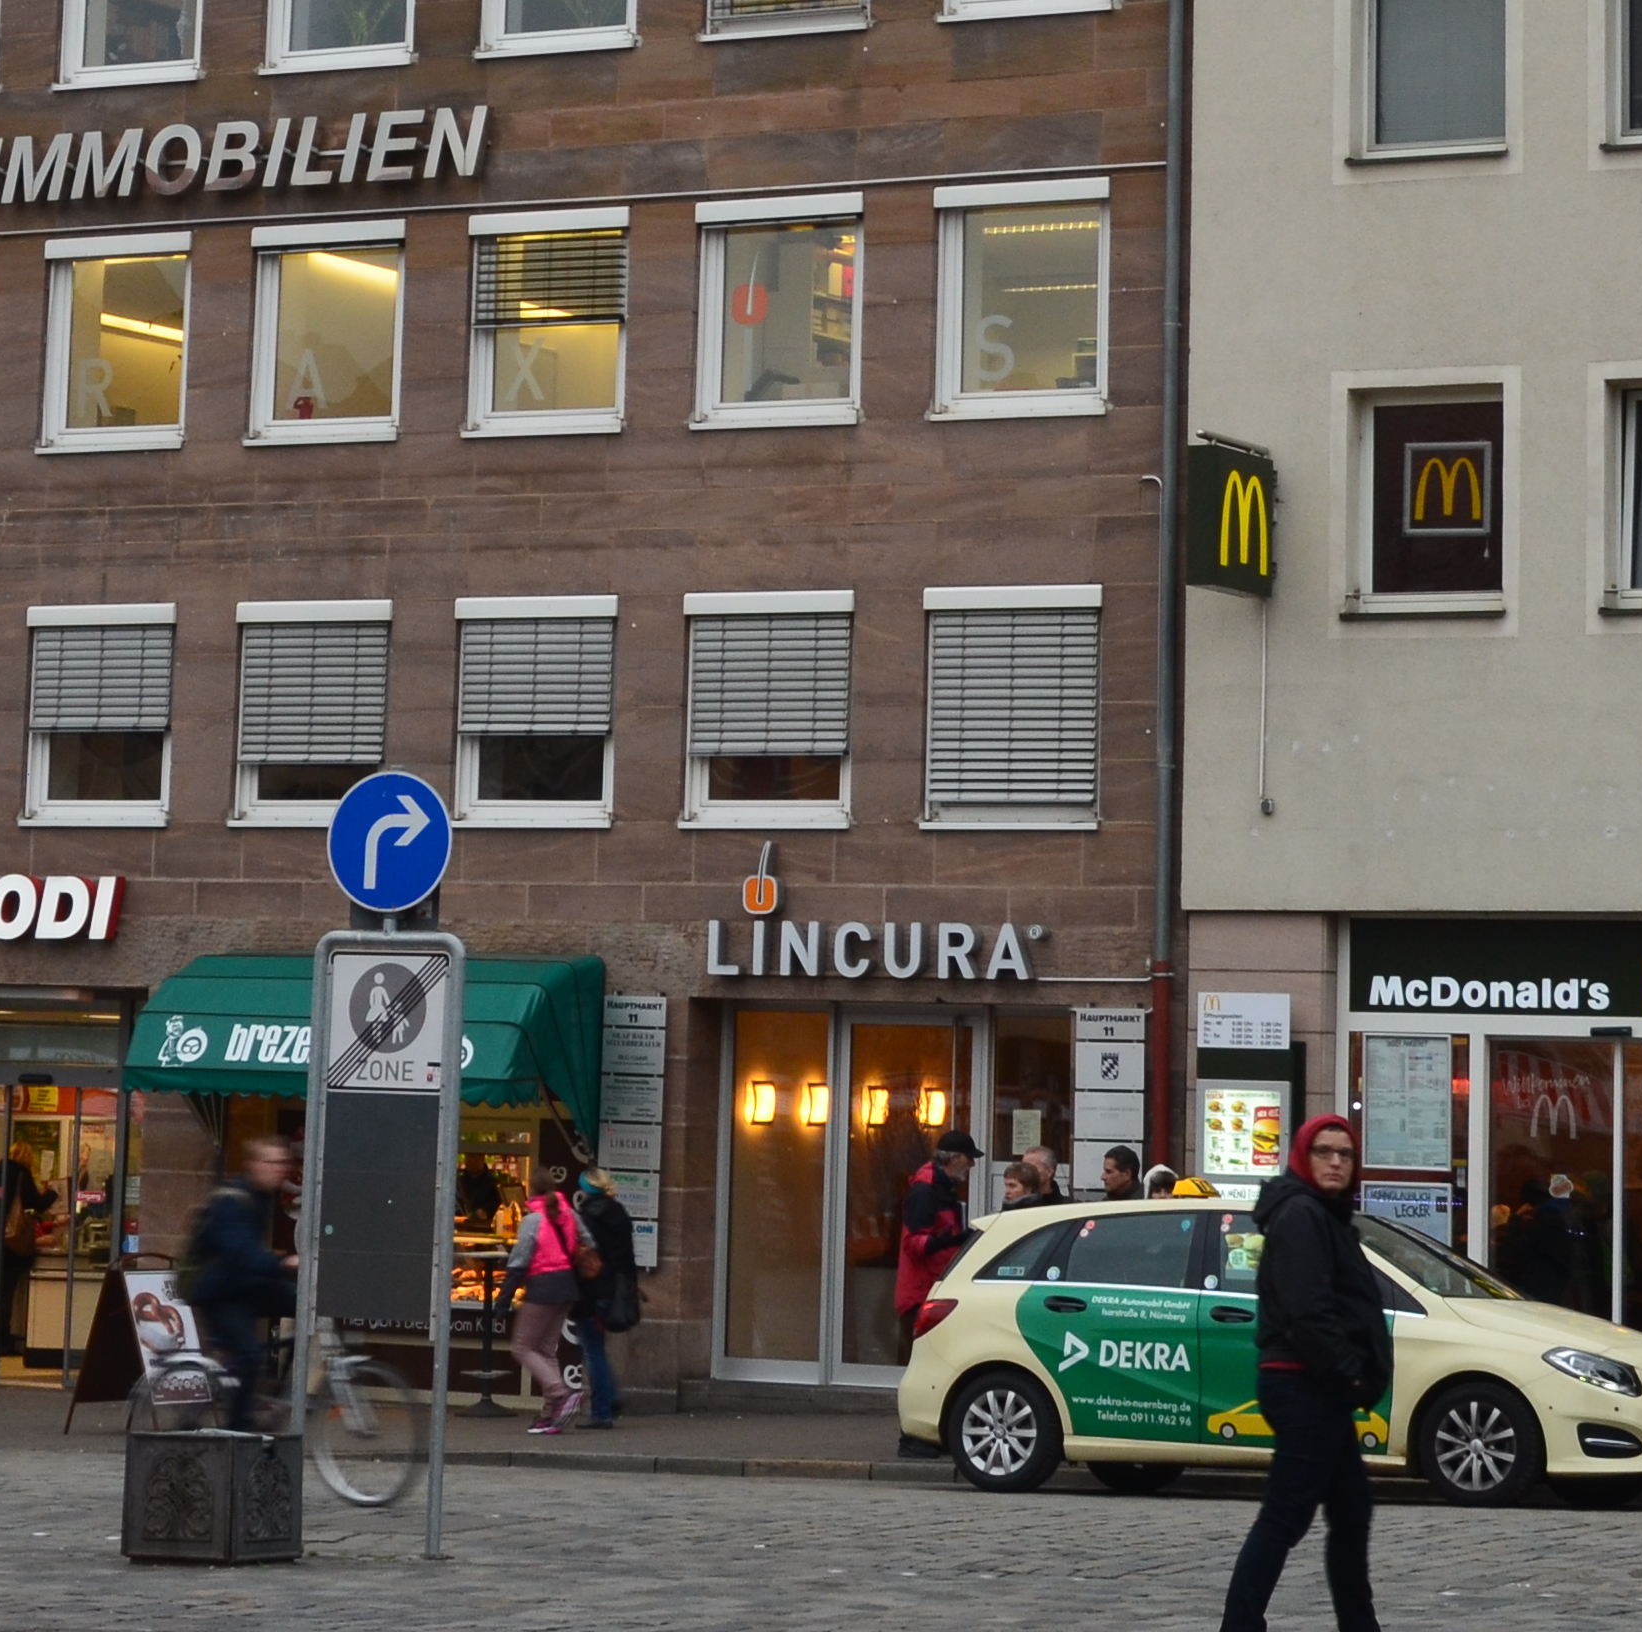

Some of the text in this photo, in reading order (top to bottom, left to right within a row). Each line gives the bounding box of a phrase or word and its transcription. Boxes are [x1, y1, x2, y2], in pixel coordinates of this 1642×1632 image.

[707, 919, 1030, 980] LINCURA
[1369, 975, 1610, 1011] McDonald's
[607, 1000, 663, 1010] HAUPTMARKT
[628, 1013, 639, 1024] 11
[1079, 1013, 1142, 1023] HAUPTMARKT
[1103, 1026, 1115, 1037] 11
[356, 1059, 415, 1082] ZONE
[610, 1139, 649, 1149] LINCURA
[77, 1191, 102, 1203] Eingang
[1394, 1203, 1431, 1219] LECKER
[1091, 1295, 1191, 1309] DEKRA Automobil GmbH
[1149, 1310, 1186, 1323] Nürnberg
[1099, 1339, 1191, 1372] DEKRA
[1071, 1394, 1191, 1413] www.dekra-in-nuernberg.de
[1097, 1410, 1192, 1427] Telefon 0911.962 96
